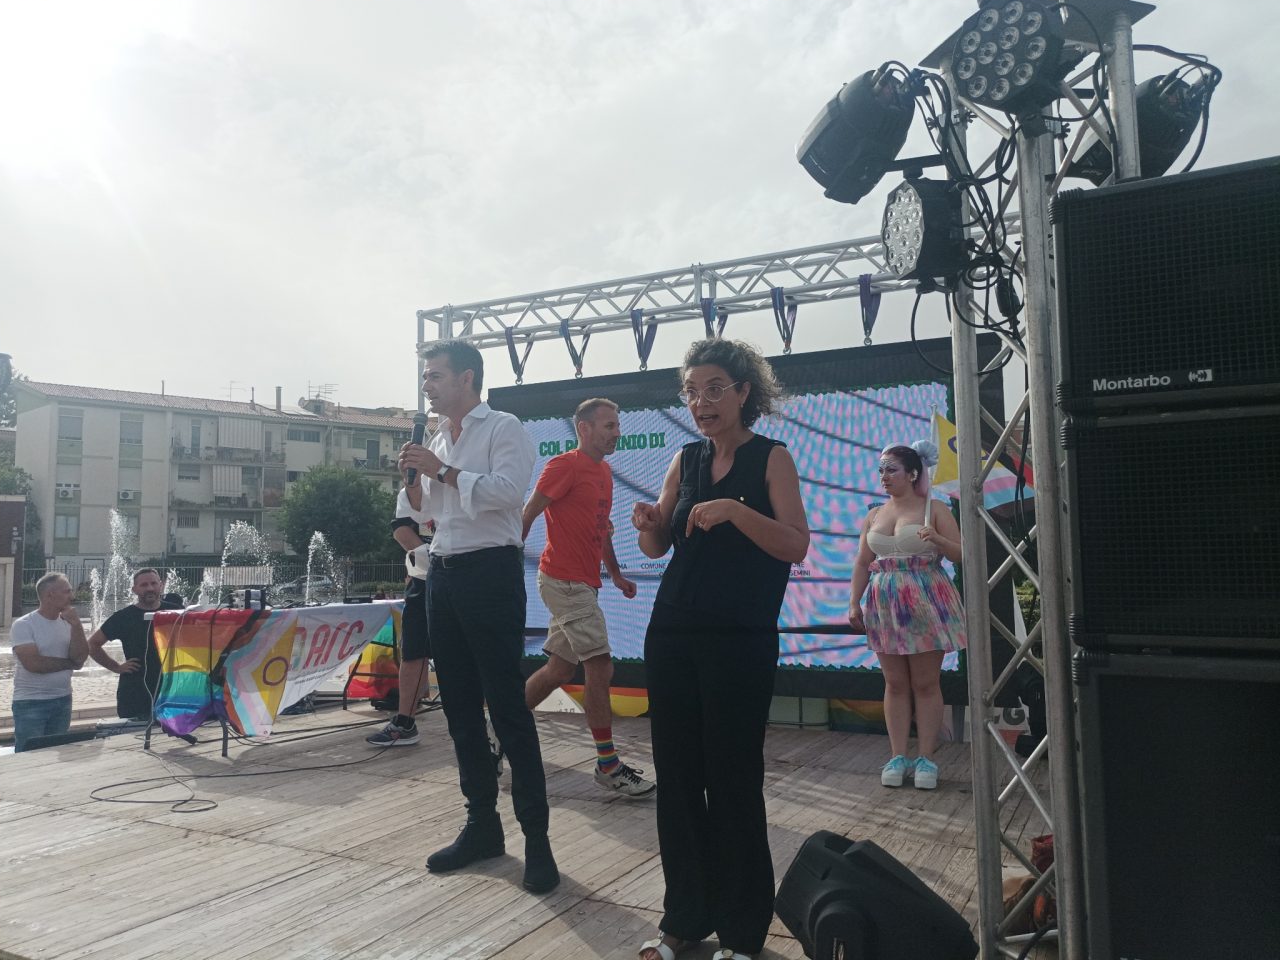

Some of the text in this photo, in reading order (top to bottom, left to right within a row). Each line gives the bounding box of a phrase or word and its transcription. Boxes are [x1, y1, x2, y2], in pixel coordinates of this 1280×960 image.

[1092, 374, 1171, 392] Montarbo
[539, 440, 562, 457] COL
[648, 432, 666, 449] DI
